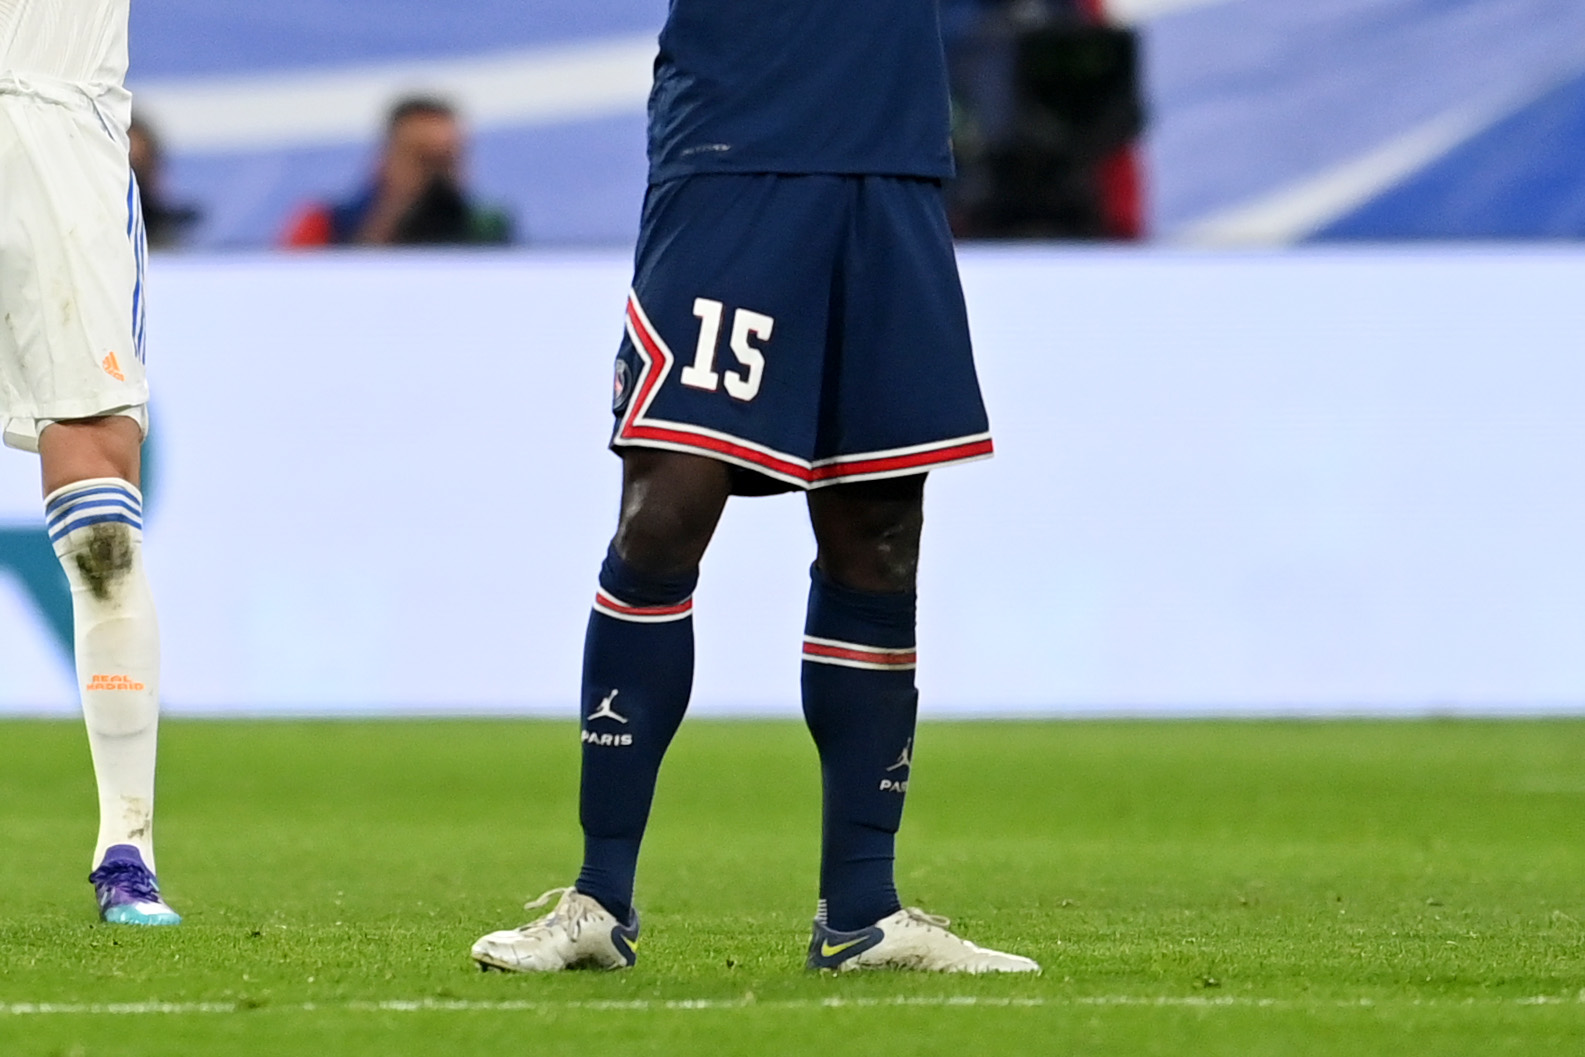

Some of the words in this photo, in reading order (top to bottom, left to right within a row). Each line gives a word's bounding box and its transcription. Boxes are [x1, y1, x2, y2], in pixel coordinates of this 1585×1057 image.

[680, 297, 774, 401] 15
[92, 674, 133, 683] REAL
[581, 730, 632, 746] PARIS
